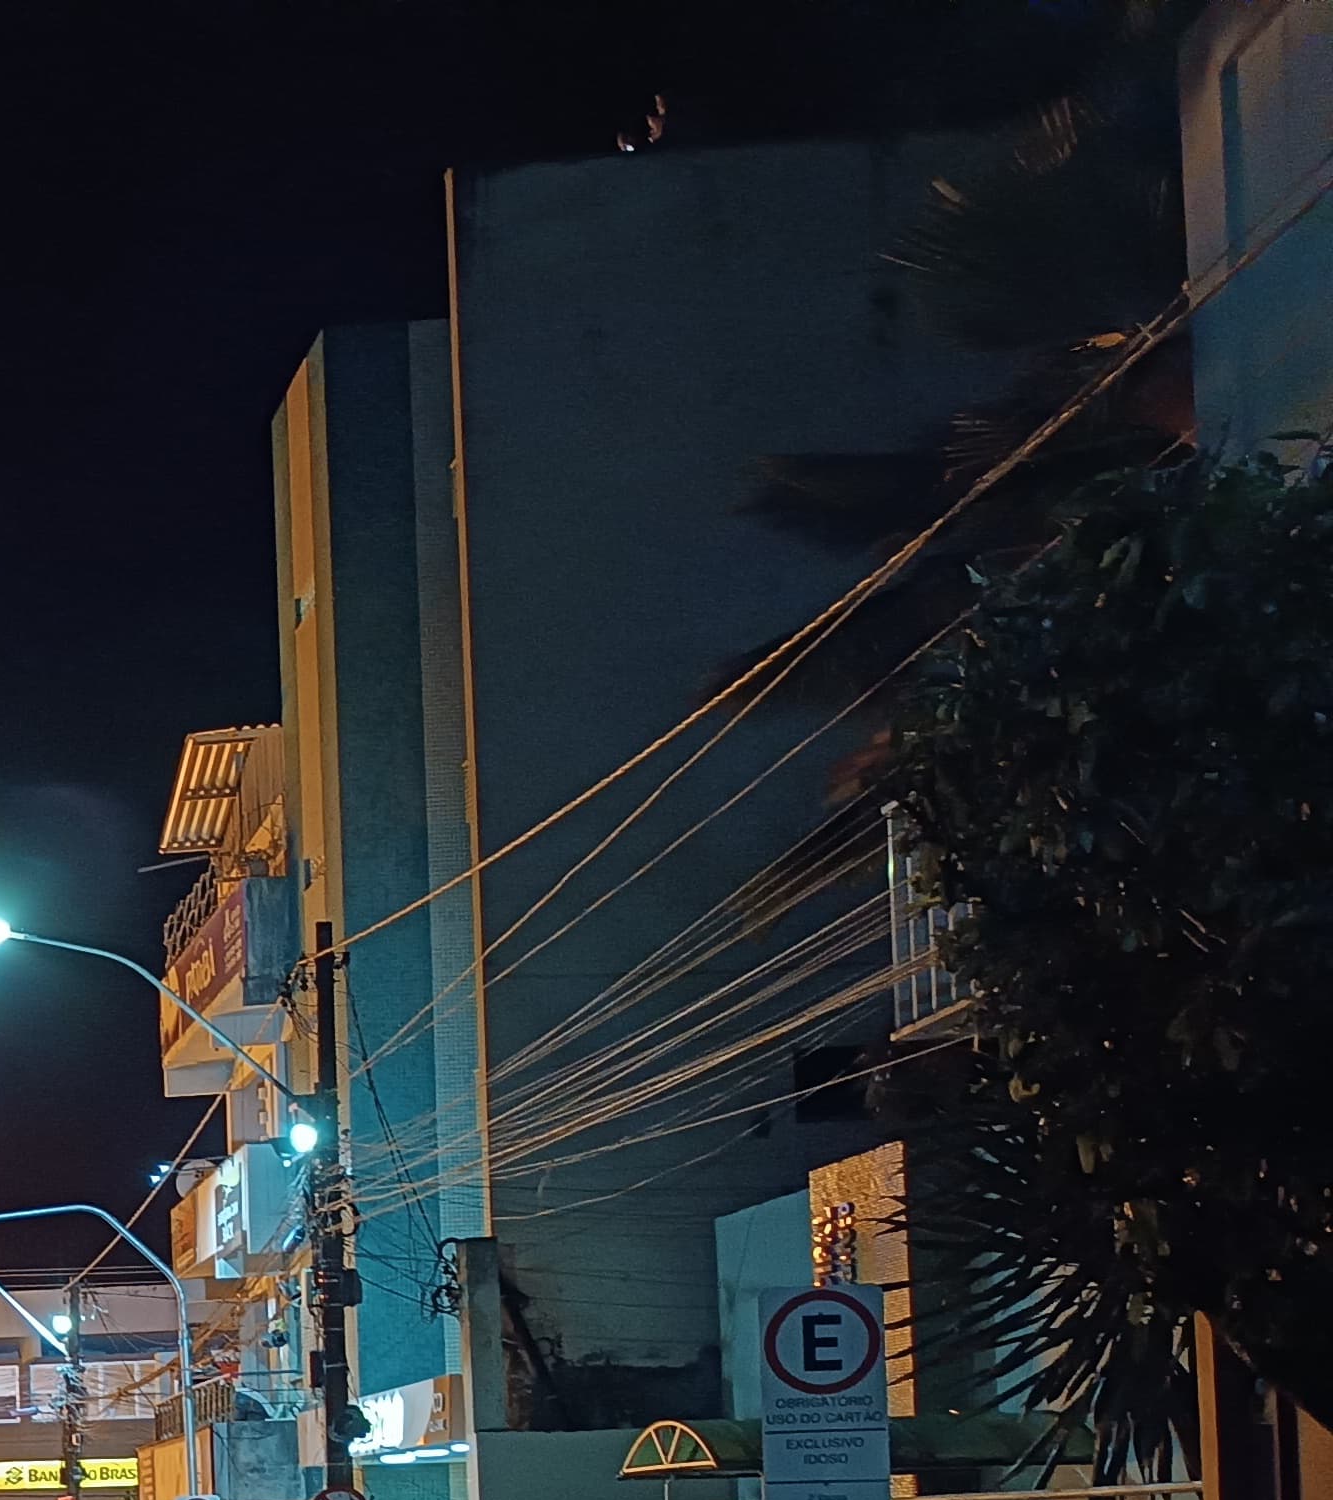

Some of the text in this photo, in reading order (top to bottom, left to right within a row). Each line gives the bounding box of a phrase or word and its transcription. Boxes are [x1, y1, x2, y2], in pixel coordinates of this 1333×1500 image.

[802, 1314, 842, 1371] E
[800, 1413, 822, 1425] DO
[786, 1437, 864, 1450] EXCLUSIVO
[804, 1453, 849, 1465] IDOSO
